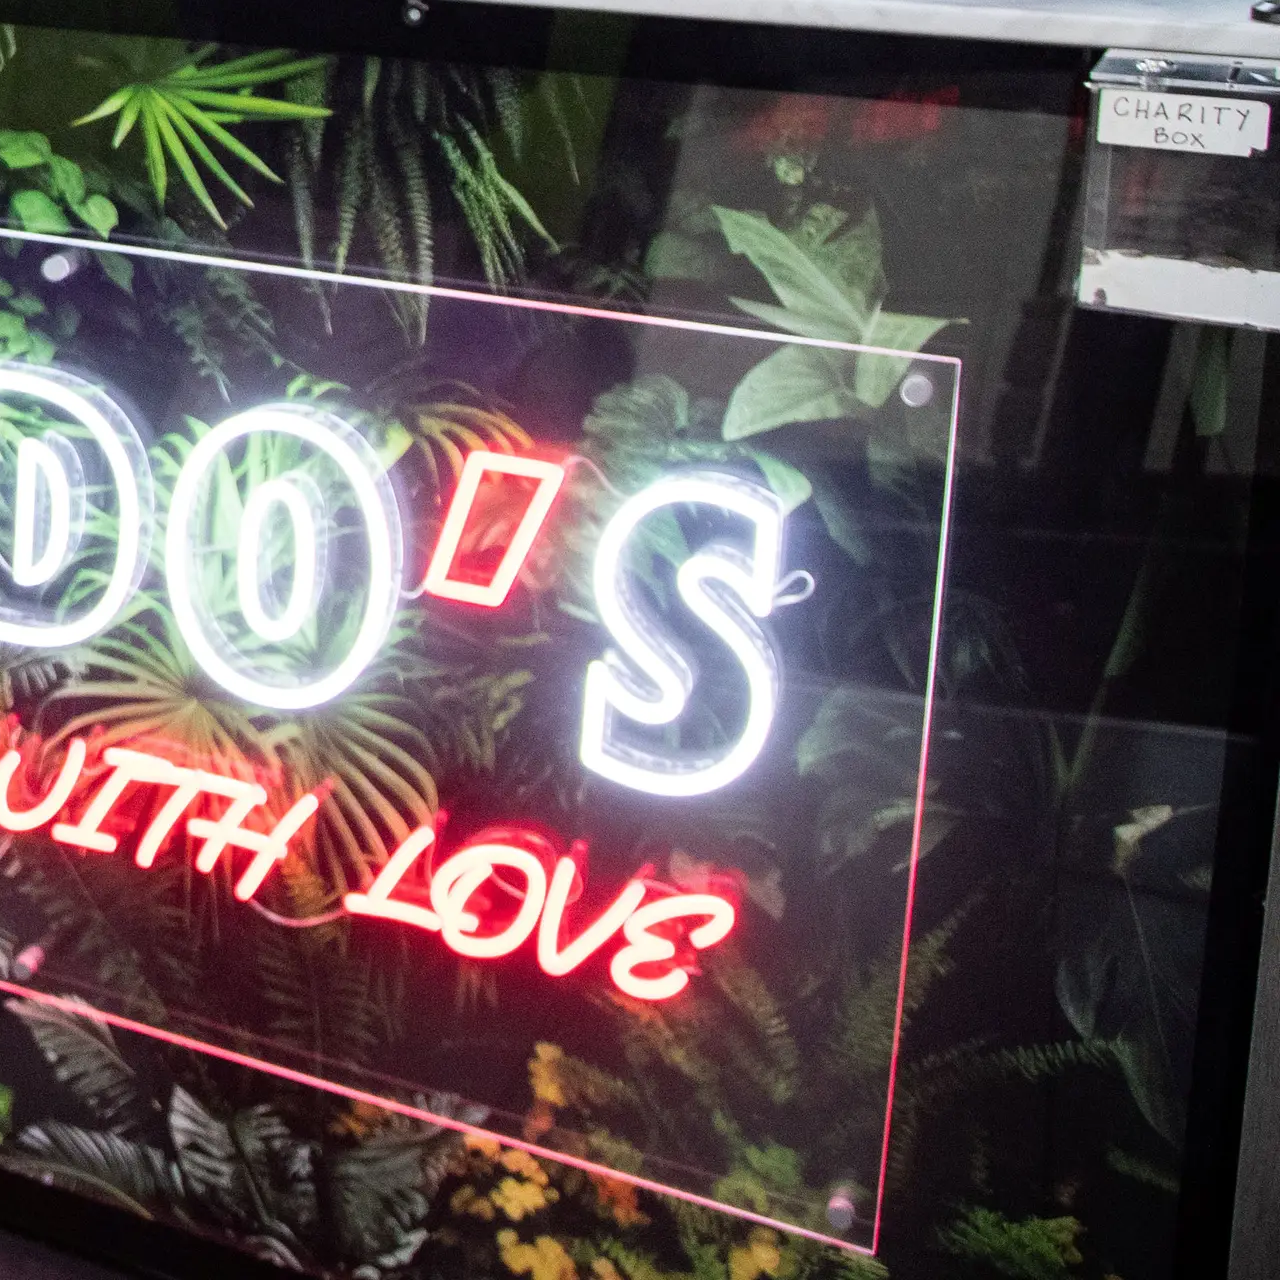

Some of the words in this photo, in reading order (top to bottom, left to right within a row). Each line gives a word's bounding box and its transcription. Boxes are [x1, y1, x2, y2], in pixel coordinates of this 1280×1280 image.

[1113, 96, 1251, 132] CHARITY
[1154, 126, 1206, 150] BOX
[344, 826, 736, 1002] LOVE
